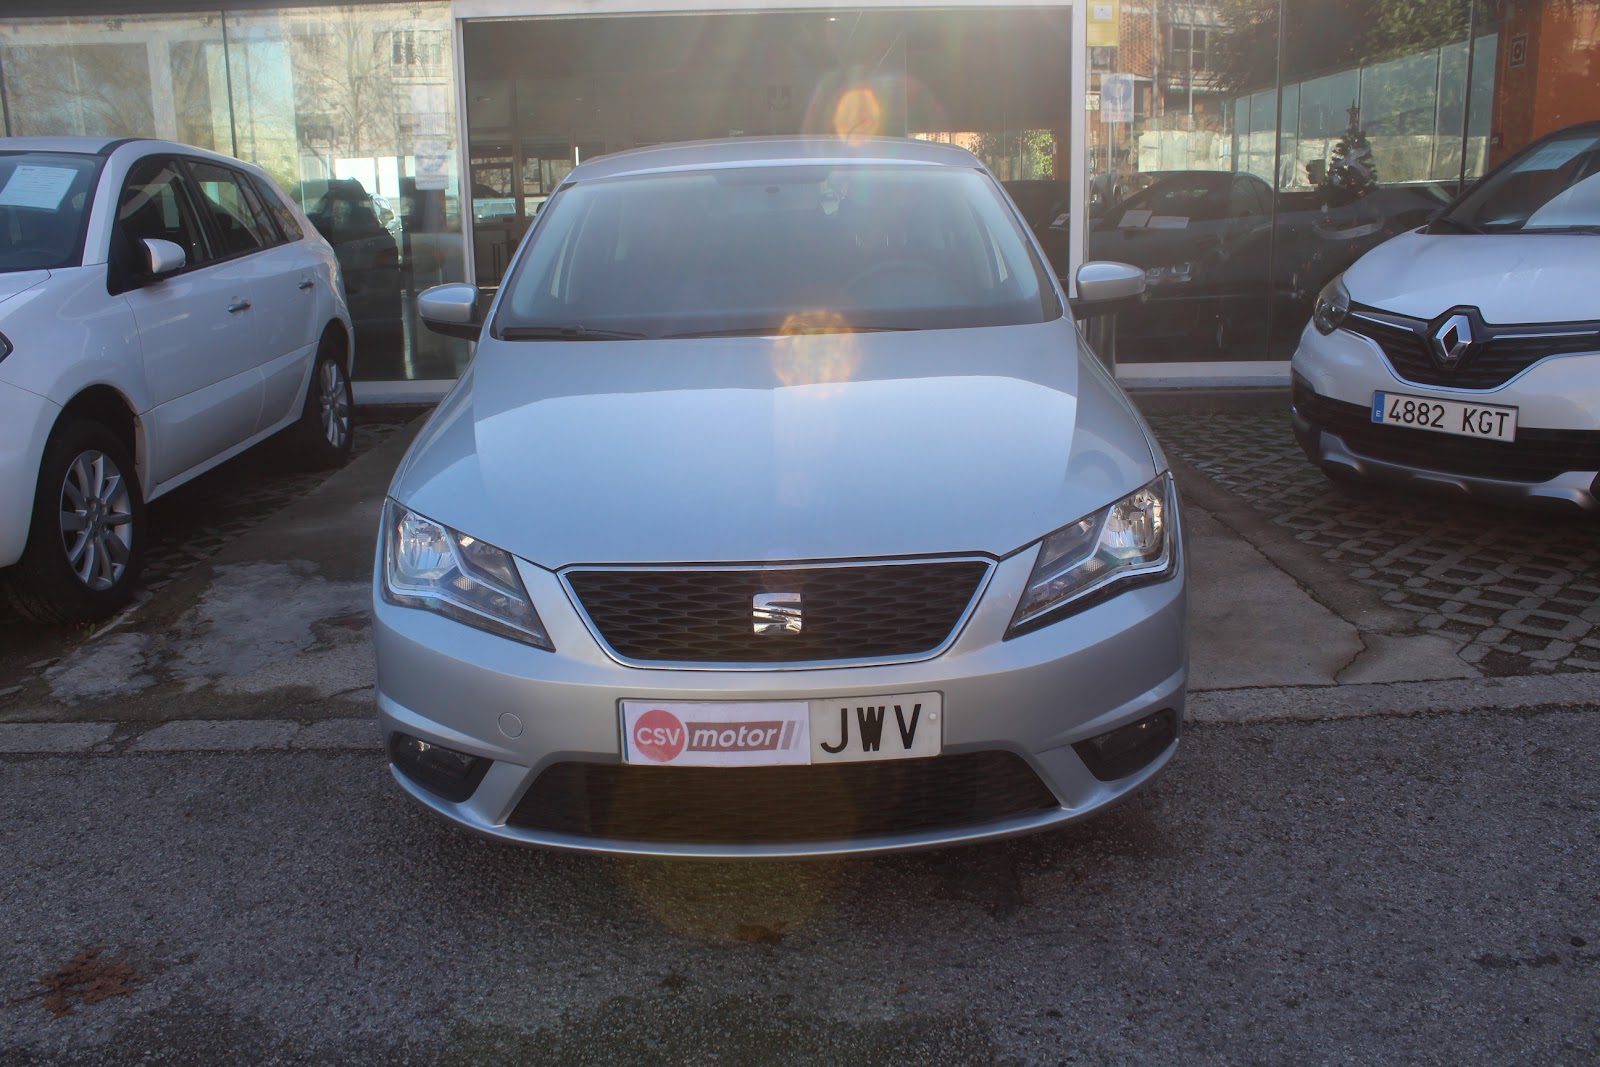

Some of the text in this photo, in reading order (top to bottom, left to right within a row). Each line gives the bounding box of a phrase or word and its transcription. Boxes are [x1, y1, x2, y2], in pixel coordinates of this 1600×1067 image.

[1388, 399, 1510, 436] 4882 KGT
[636, 725, 778, 748] CSV motor
[820, 703, 922, 754] JWV
